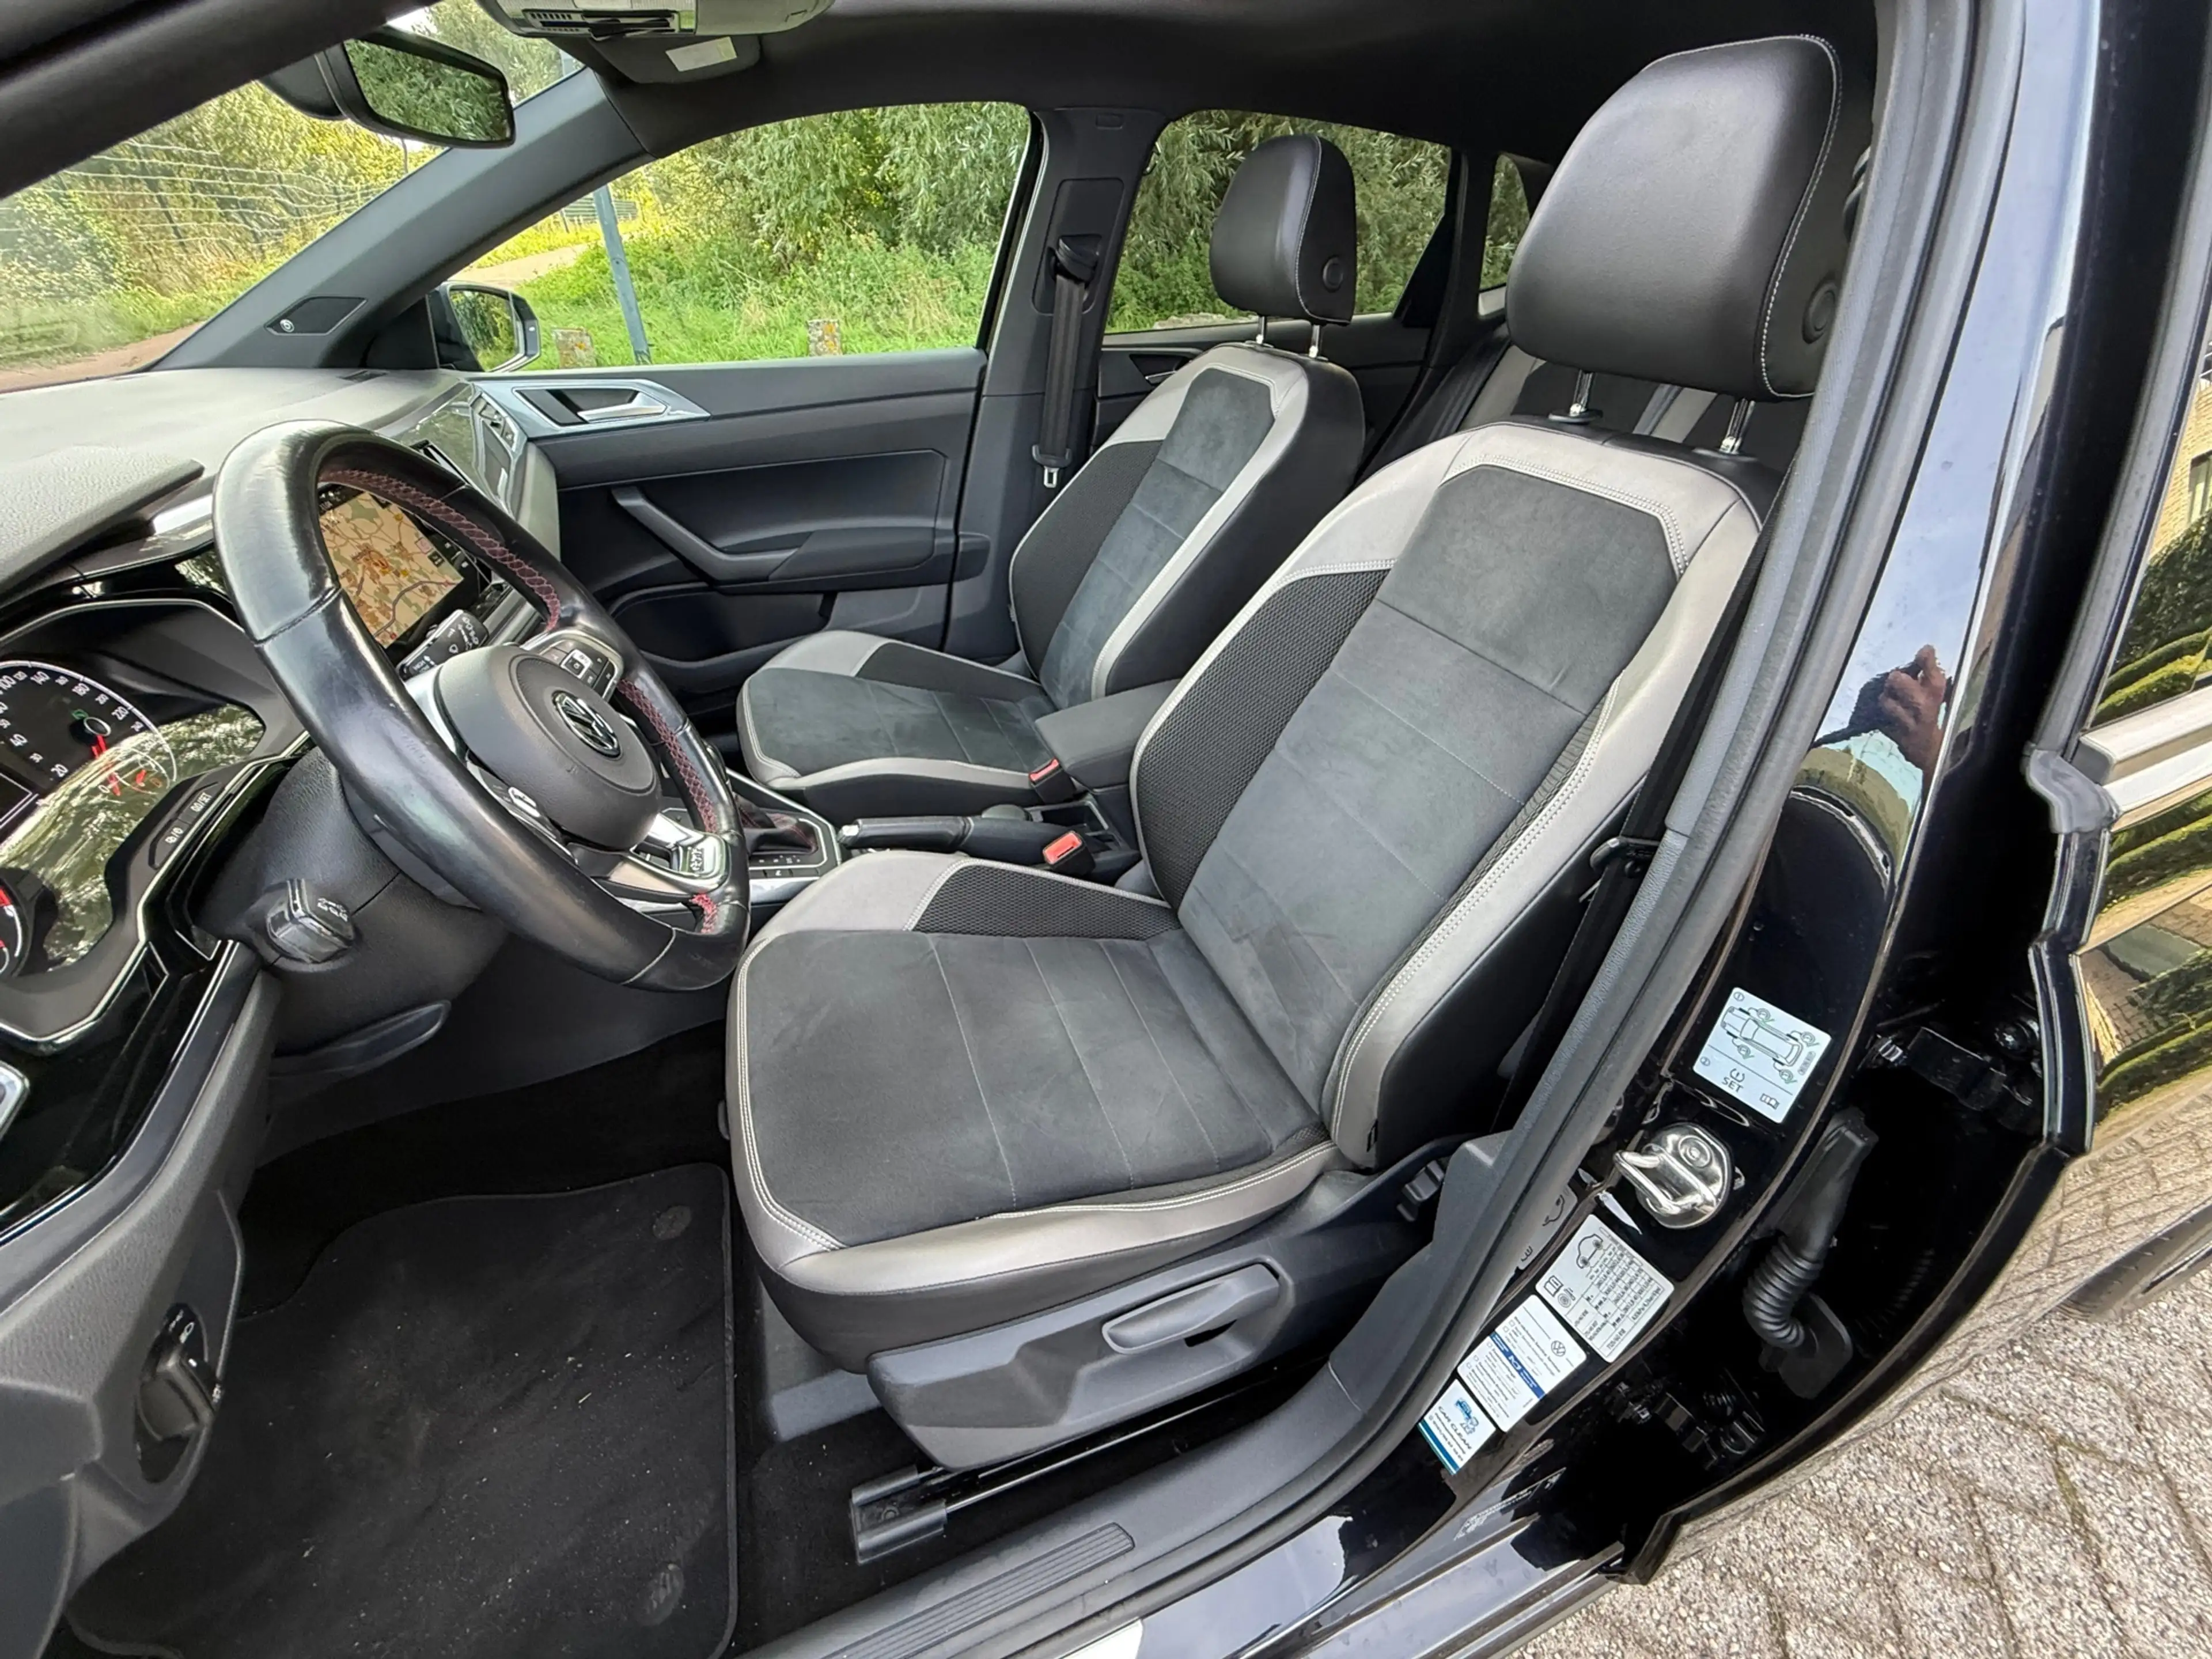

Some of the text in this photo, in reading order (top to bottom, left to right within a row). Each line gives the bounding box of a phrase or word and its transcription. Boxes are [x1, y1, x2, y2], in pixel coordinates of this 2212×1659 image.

[31, 671, 50, 685] 140
[71, 683, 90, 696] 180
[111, 706, 128, 720] 220
[9, 733, 27, 747] 40
[29, 752, 43, 763] 30
[51, 764, 68, 777] 20
[1722, 1077, 1744, 1093] SET
[1450, 1423, 1472, 1449] CLEAN
